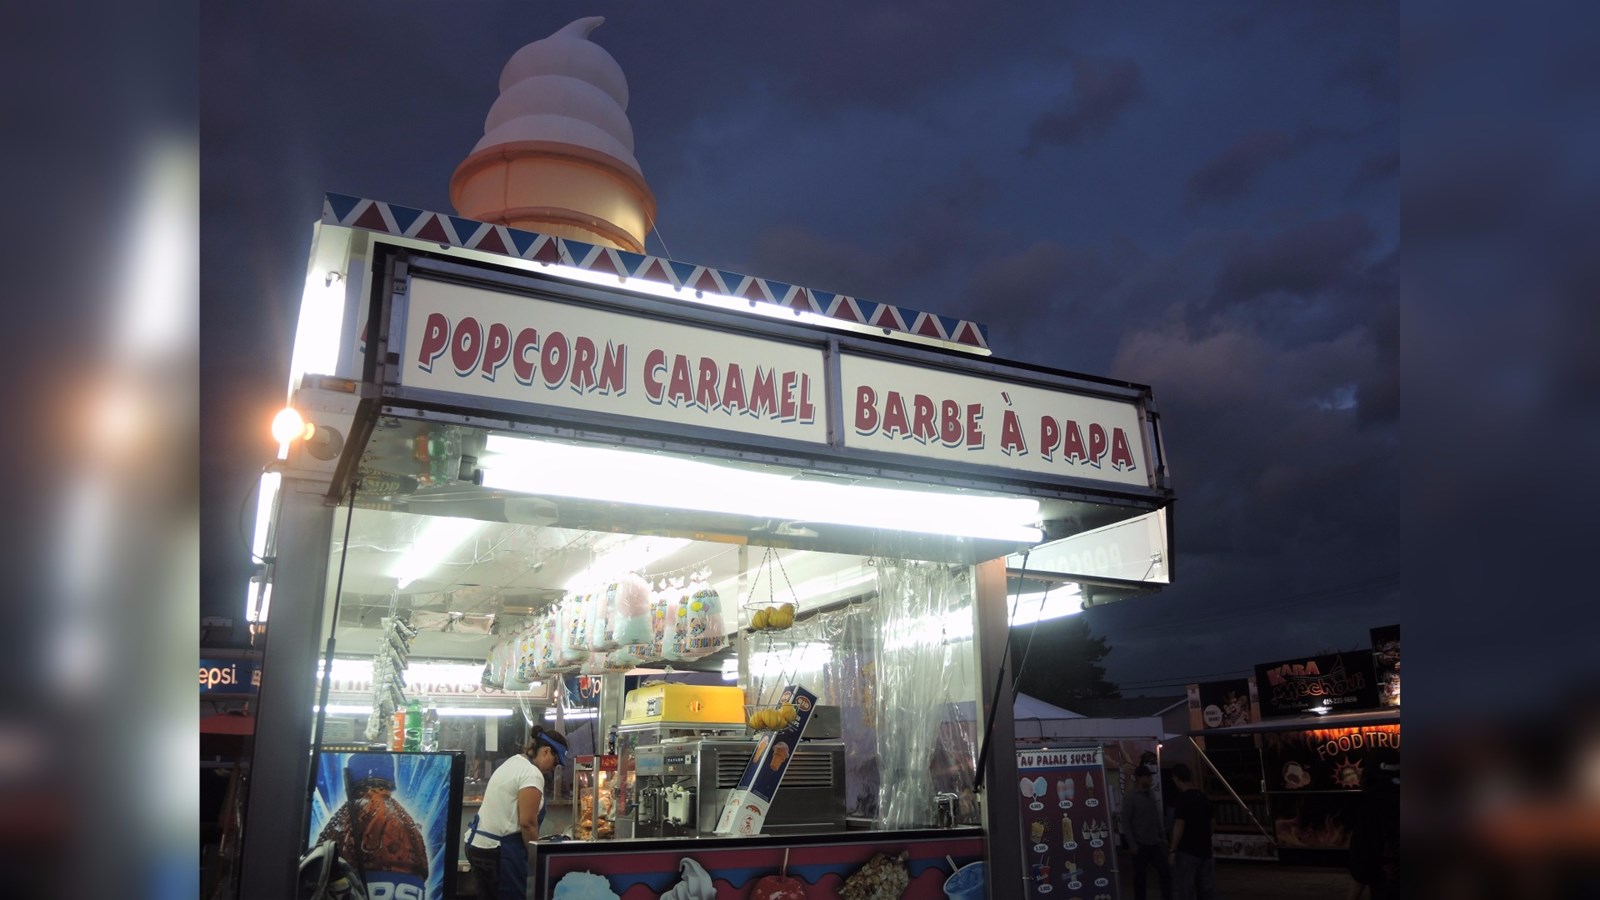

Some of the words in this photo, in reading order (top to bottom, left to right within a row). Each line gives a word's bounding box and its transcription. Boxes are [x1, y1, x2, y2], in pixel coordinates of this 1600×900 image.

[418, 312, 628, 397] POPCORN
[643, 347, 816, 426] CARAMEL
[854, 385, 984, 451] BARBE
[1000, 391, 1028, 456] À
[1040, 415, 1136, 471] PAPA
[1266, 661, 1320, 687] KARA
[1317, 733, 1363, 760] FOOD
[1021, 756, 1033, 767] AU
[1037, 755, 1067, 766] PALAIS
